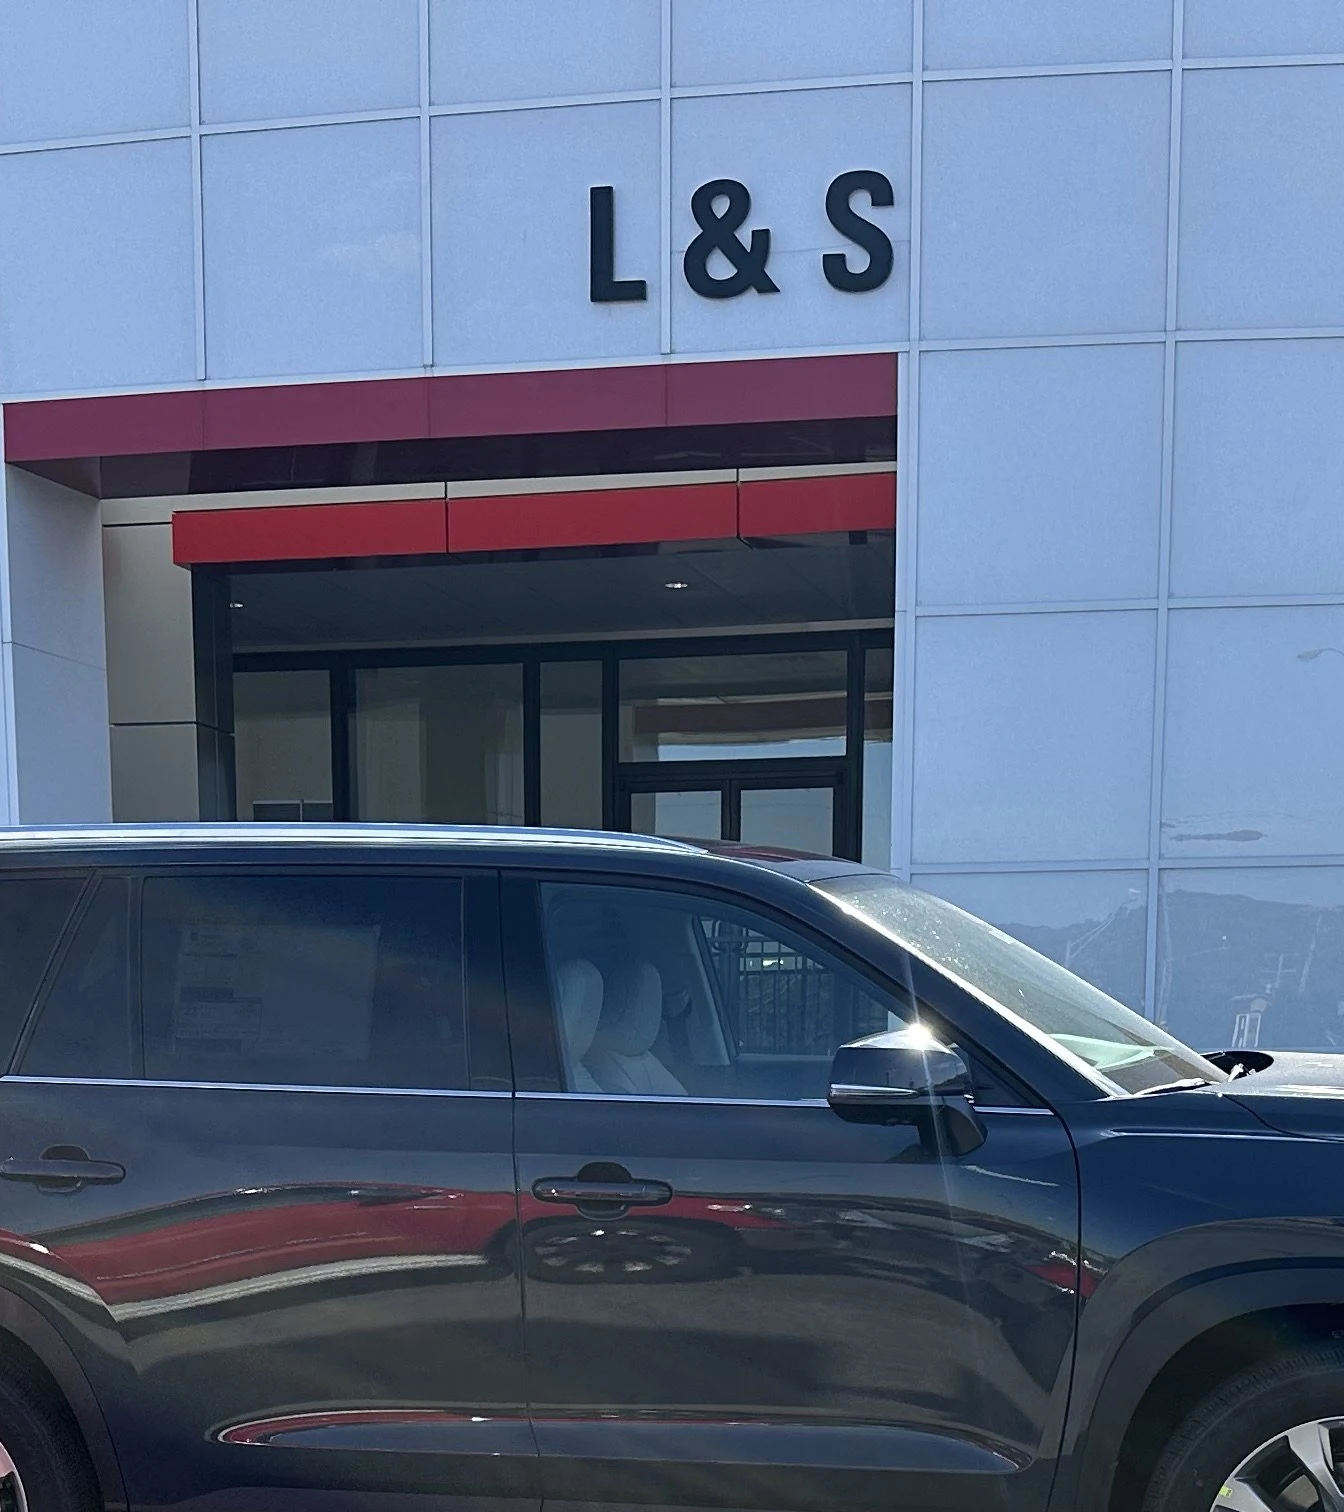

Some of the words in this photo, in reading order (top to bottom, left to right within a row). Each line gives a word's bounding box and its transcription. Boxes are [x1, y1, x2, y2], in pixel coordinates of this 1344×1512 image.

[590, 185, 647, 302] L
[683, 178, 781, 299] &
[822, 170, 895, 293] S
